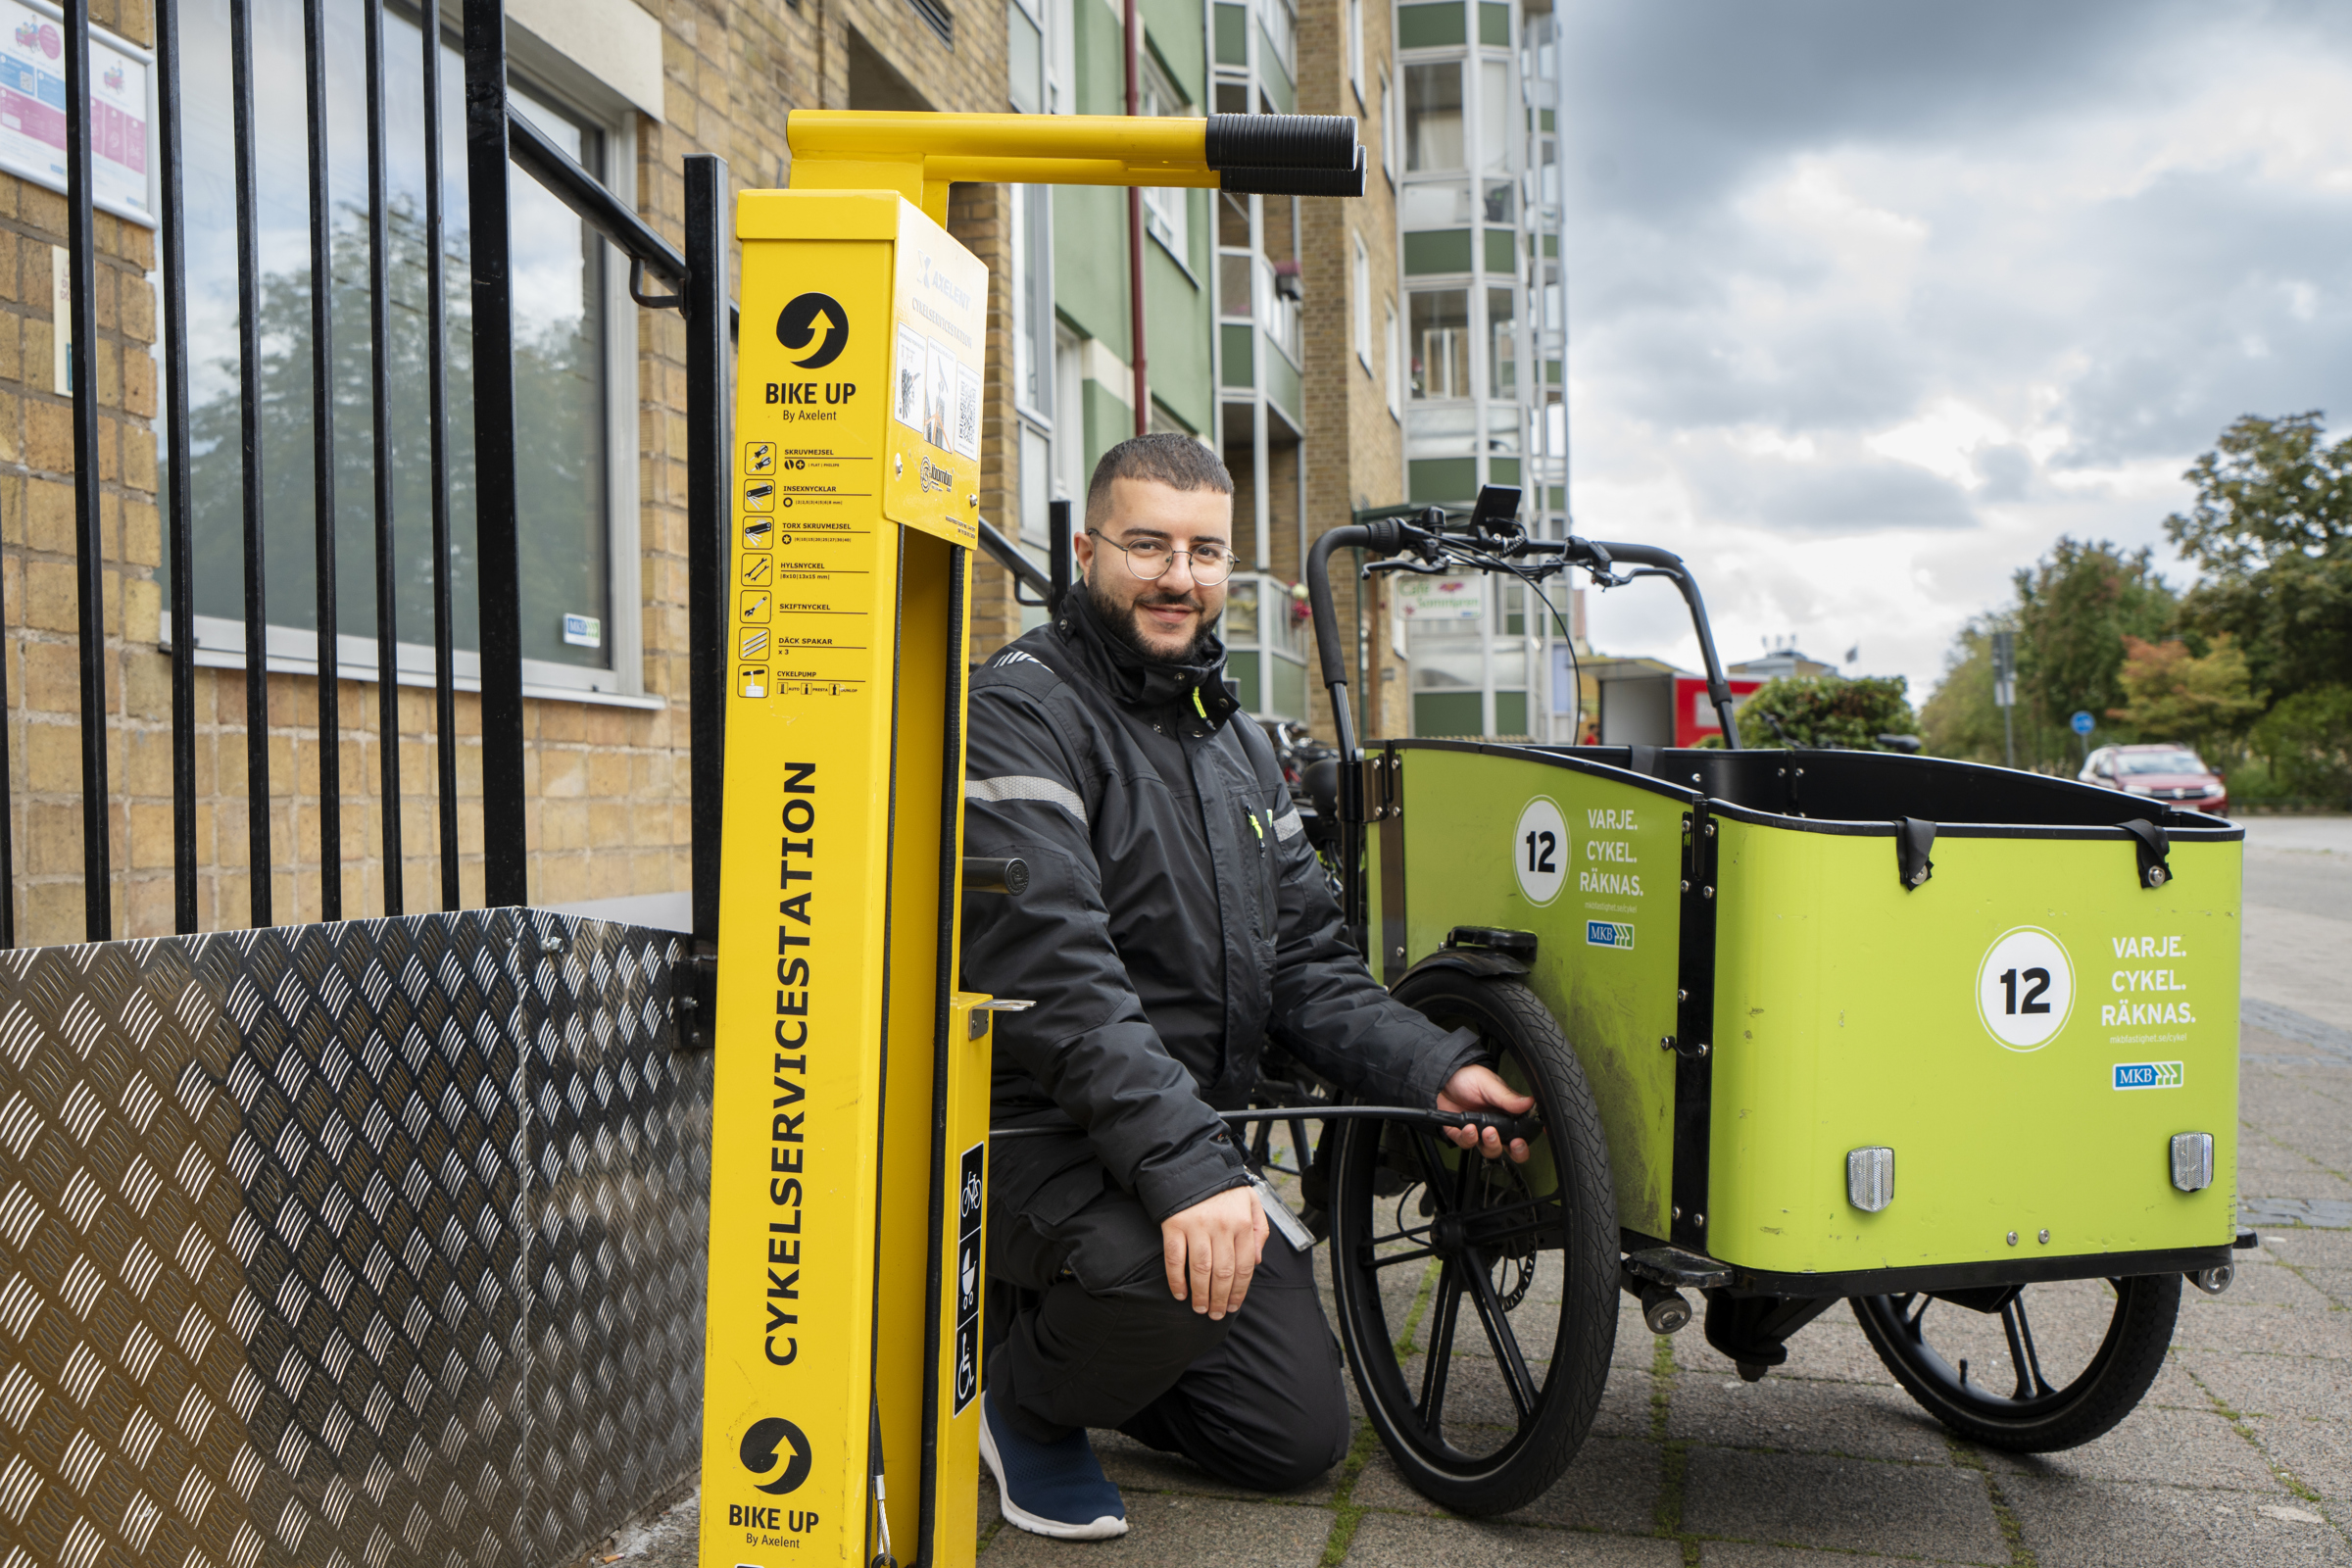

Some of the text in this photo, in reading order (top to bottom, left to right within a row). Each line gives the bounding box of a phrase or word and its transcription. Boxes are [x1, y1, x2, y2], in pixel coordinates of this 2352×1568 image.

[932, 270, 971, 312] AXELENT
[912, 296, 972, 350] CYKELSERVICESTATION
[765, 382, 857, 404] BIKE UP
[783, 410, 837, 422] By Axelent
[1588, 808, 1639, 830] VARJE.
[1526, 830, 1556, 873] 12
[1587, 841, 1638, 863] CYKEL.
[1580, 867, 1643, 897] RÄKNAS.
[1585, 901, 1638, 914] mkbfastighet.se/cykel
[1591, 925, 1613, 941] MKB
[2112, 936, 2187, 958] VARJE.
[1999, 967, 2051, 1015] 12
[2111, 969, 2186, 993] CYKEL.
[2101, 999, 2196, 1026] RÄKNAS.
[2110, 1032, 2187, 1045] mkbfastighet.se/cykel
[764, 761, 816, 1366] CYKELSERVICESTATION
[2119, 1068, 2153, 1084] MKB
[729, 1503, 819, 1534] BIKE UP
[746, 1533, 800, 1548] By Axelent
